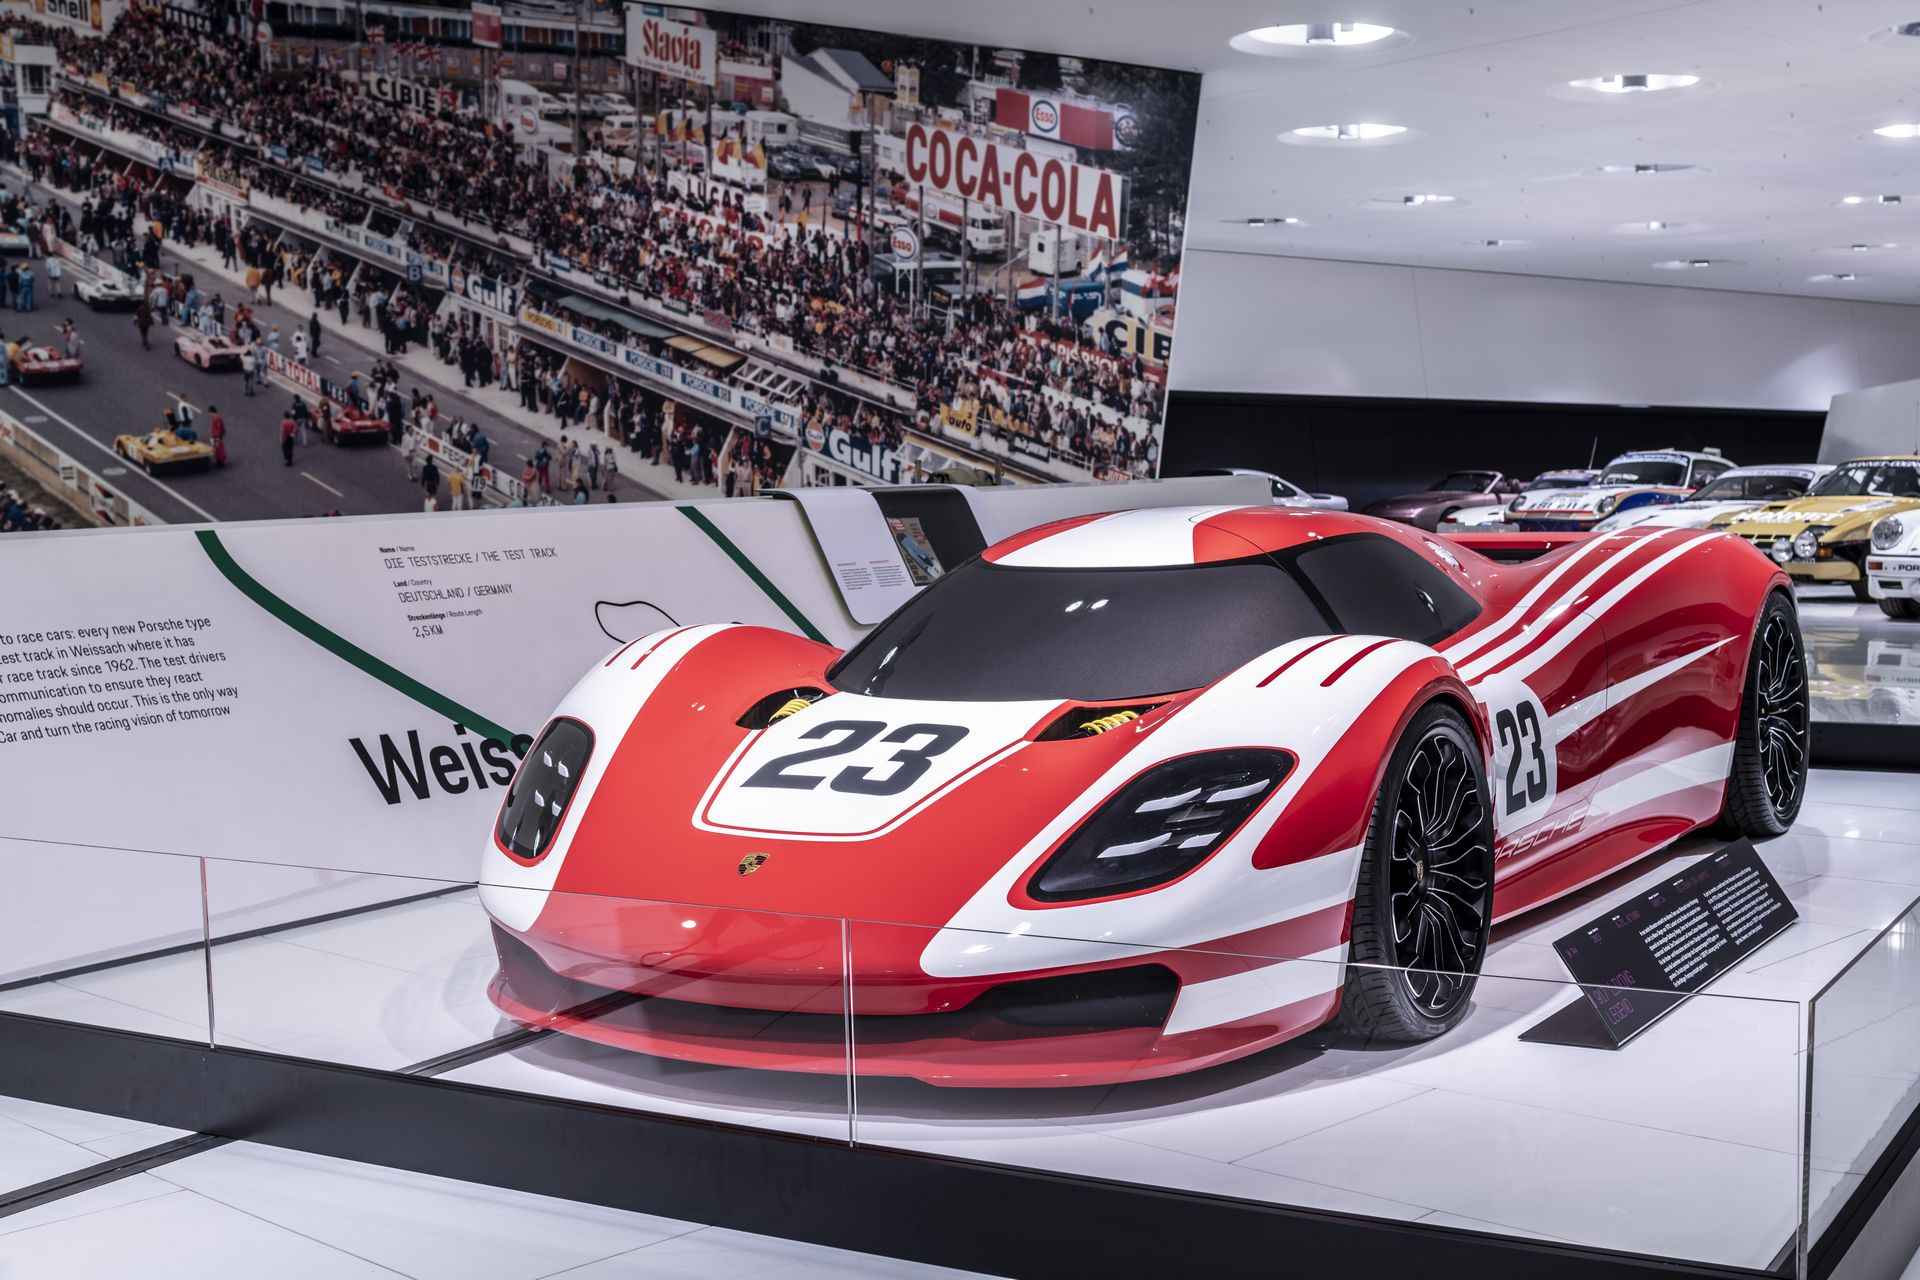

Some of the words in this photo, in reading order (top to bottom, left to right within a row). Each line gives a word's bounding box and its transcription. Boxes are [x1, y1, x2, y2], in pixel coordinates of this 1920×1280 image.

[48, 0, 88, 21] Shell
[642, 18, 701, 71] Slavia
[1035, 108, 1056, 125] Esso
[906, 124, 1117, 239] COCA-COLA
[892, 236, 913, 252] Esso
[409, 267, 421, 281] B
[467, 274, 512, 313] Gulf
[947, 415, 973, 432] auto
[829, 429, 902, 483] Gulf
[384, 557, 405, 569] DIE
[407, 553, 473, 568] TESTSTRECKE
[481, 551, 501, 562] THE
[503, 549, 526, 561] TEST
[529, 547, 558, 559] TRACK
[398, 588, 464, 603] DEUTSCHLAND
[474, 584, 514, 596] GERMANY
[411, 579, 432, 587] Country
[449, 610, 464, 618] Route
[465, 609, 483, 617] Length
[0, 634, 13, 645] to
[17, 632, 43, 644] race
[46, 629, 76, 641] cars:
[78, 626, 109, 639] every
[112, 623, 135, 635] new
[137, 618, 184, 633] Porsche
[185, 617, 211, 631] type
[413, 625, 444, 638] 2,5KM
[23, 648, 55, 661] track
[56, 647, 68, 659] in
[70, 642, 126, 657] Weissach
[128, 639, 162, 652] where
[163, 637, 173, 648] it
[174, 636, 195, 647] has
[7, 671, 34, 683] race
[36, 667, 68, 680] track
[71, 663, 102, 677] since
[104, 659, 138, 673] 1962.
[139, 657, 161, 669] The
[164, 655, 187, 667] test
[189, 651, 226, 664] drivers
[89, 682, 102, 694] to
[104, 679, 144, 692] ensure
[146, 675, 171, 687] they
[174, 671, 203, 683] react
[56, 702, 95, 716] should
[97, 698, 133, 712] occur.
[133, 693, 158, 707] This
[159, 693, 170, 704] is
[171, 690, 190, 703] the
[192, 687, 215, 701] only
[217, 686, 238, 698] way
[21, 727, 43, 741] and
[45, 724, 70, 738] turn
[72, 721, 92, 734] the
[95, 716, 130, 731] racing
[132, 712, 164, 727] vision
[166, 709, 178, 721] of
[179, 705, 230, 720] tomorrow
[740, 720, 970, 796] 23
[1496, 700, 1547, 815] 23
